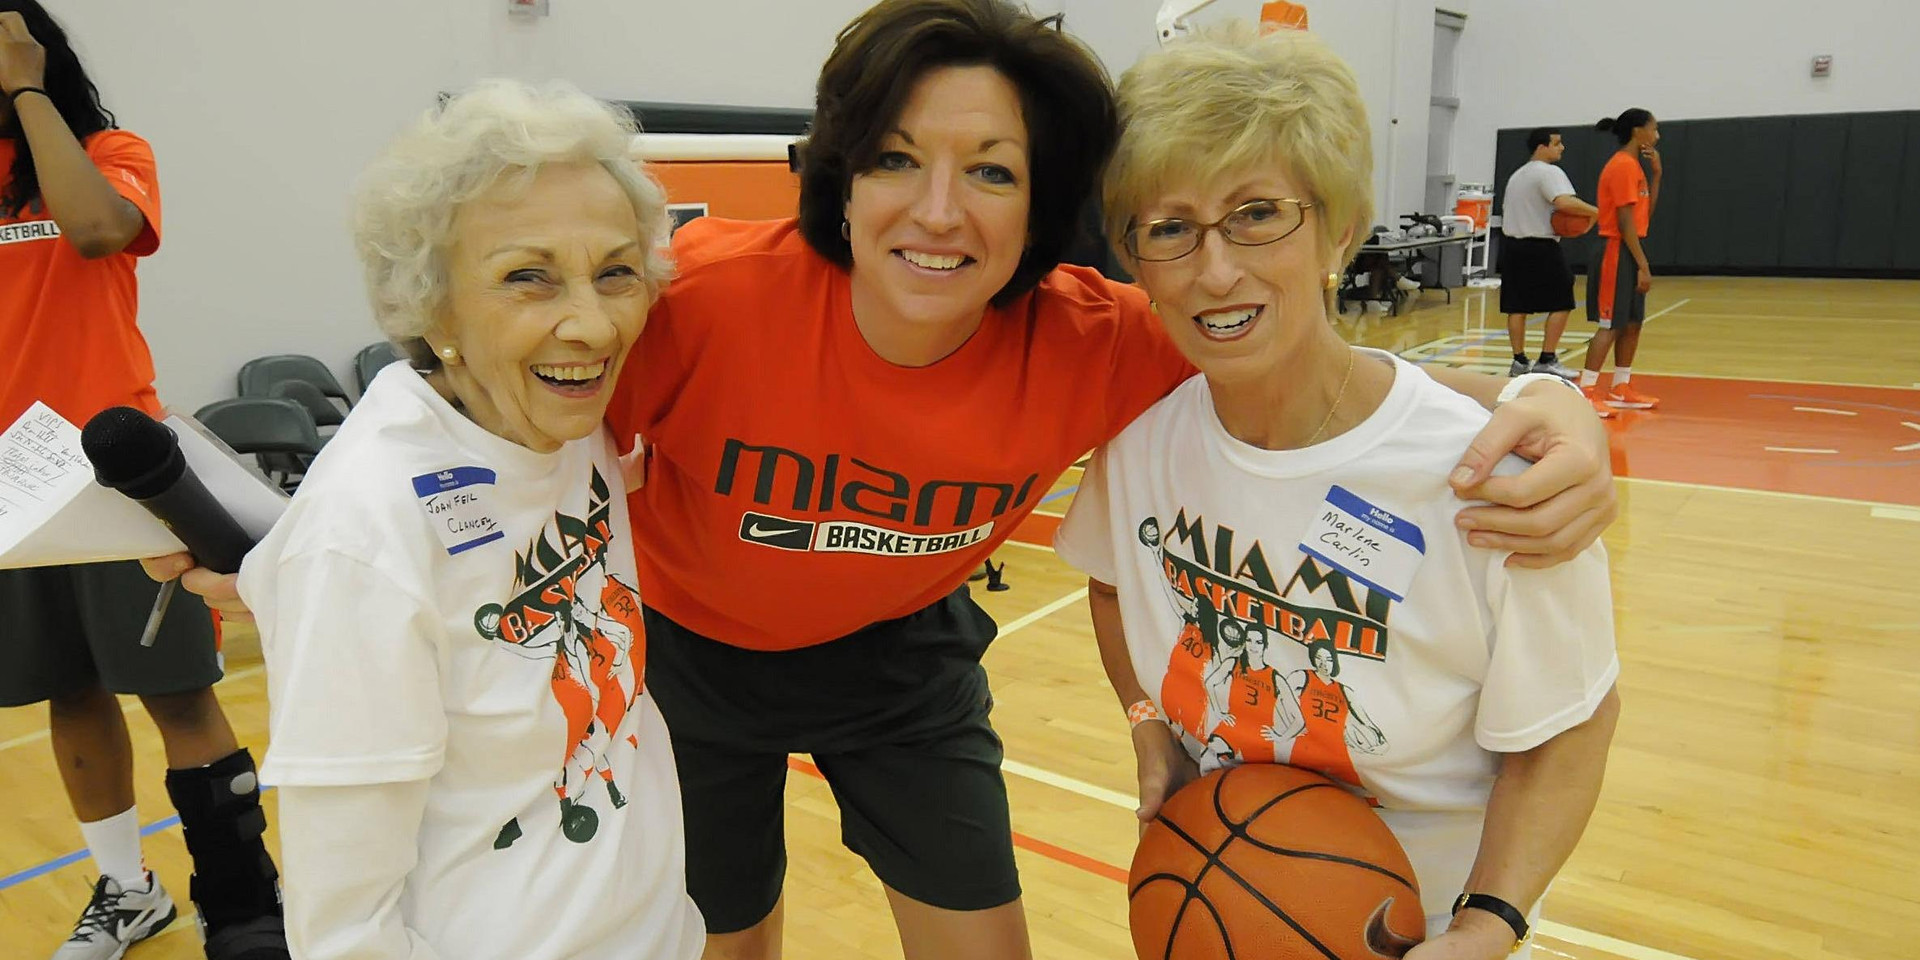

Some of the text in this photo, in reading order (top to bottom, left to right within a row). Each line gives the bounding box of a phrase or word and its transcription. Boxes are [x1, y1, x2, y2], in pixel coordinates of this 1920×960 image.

[1361, 513, 1371, 522] my
[1369, 507, 1394, 524] Hello
[826, 525, 981, 554] BASKETBALL
[1322, 511, 1381, 552] Marlene
[1320, 532, 1370, 566] Carlin
[1164, 506, 1391, 628] MIAMI
[1164, 556, 1386, 659] BASKETBALL
[1182, 636, 1204, 660] 40
[1245, 684, 1258, 706] 3
[1312, 698, 1339, 722] 32
